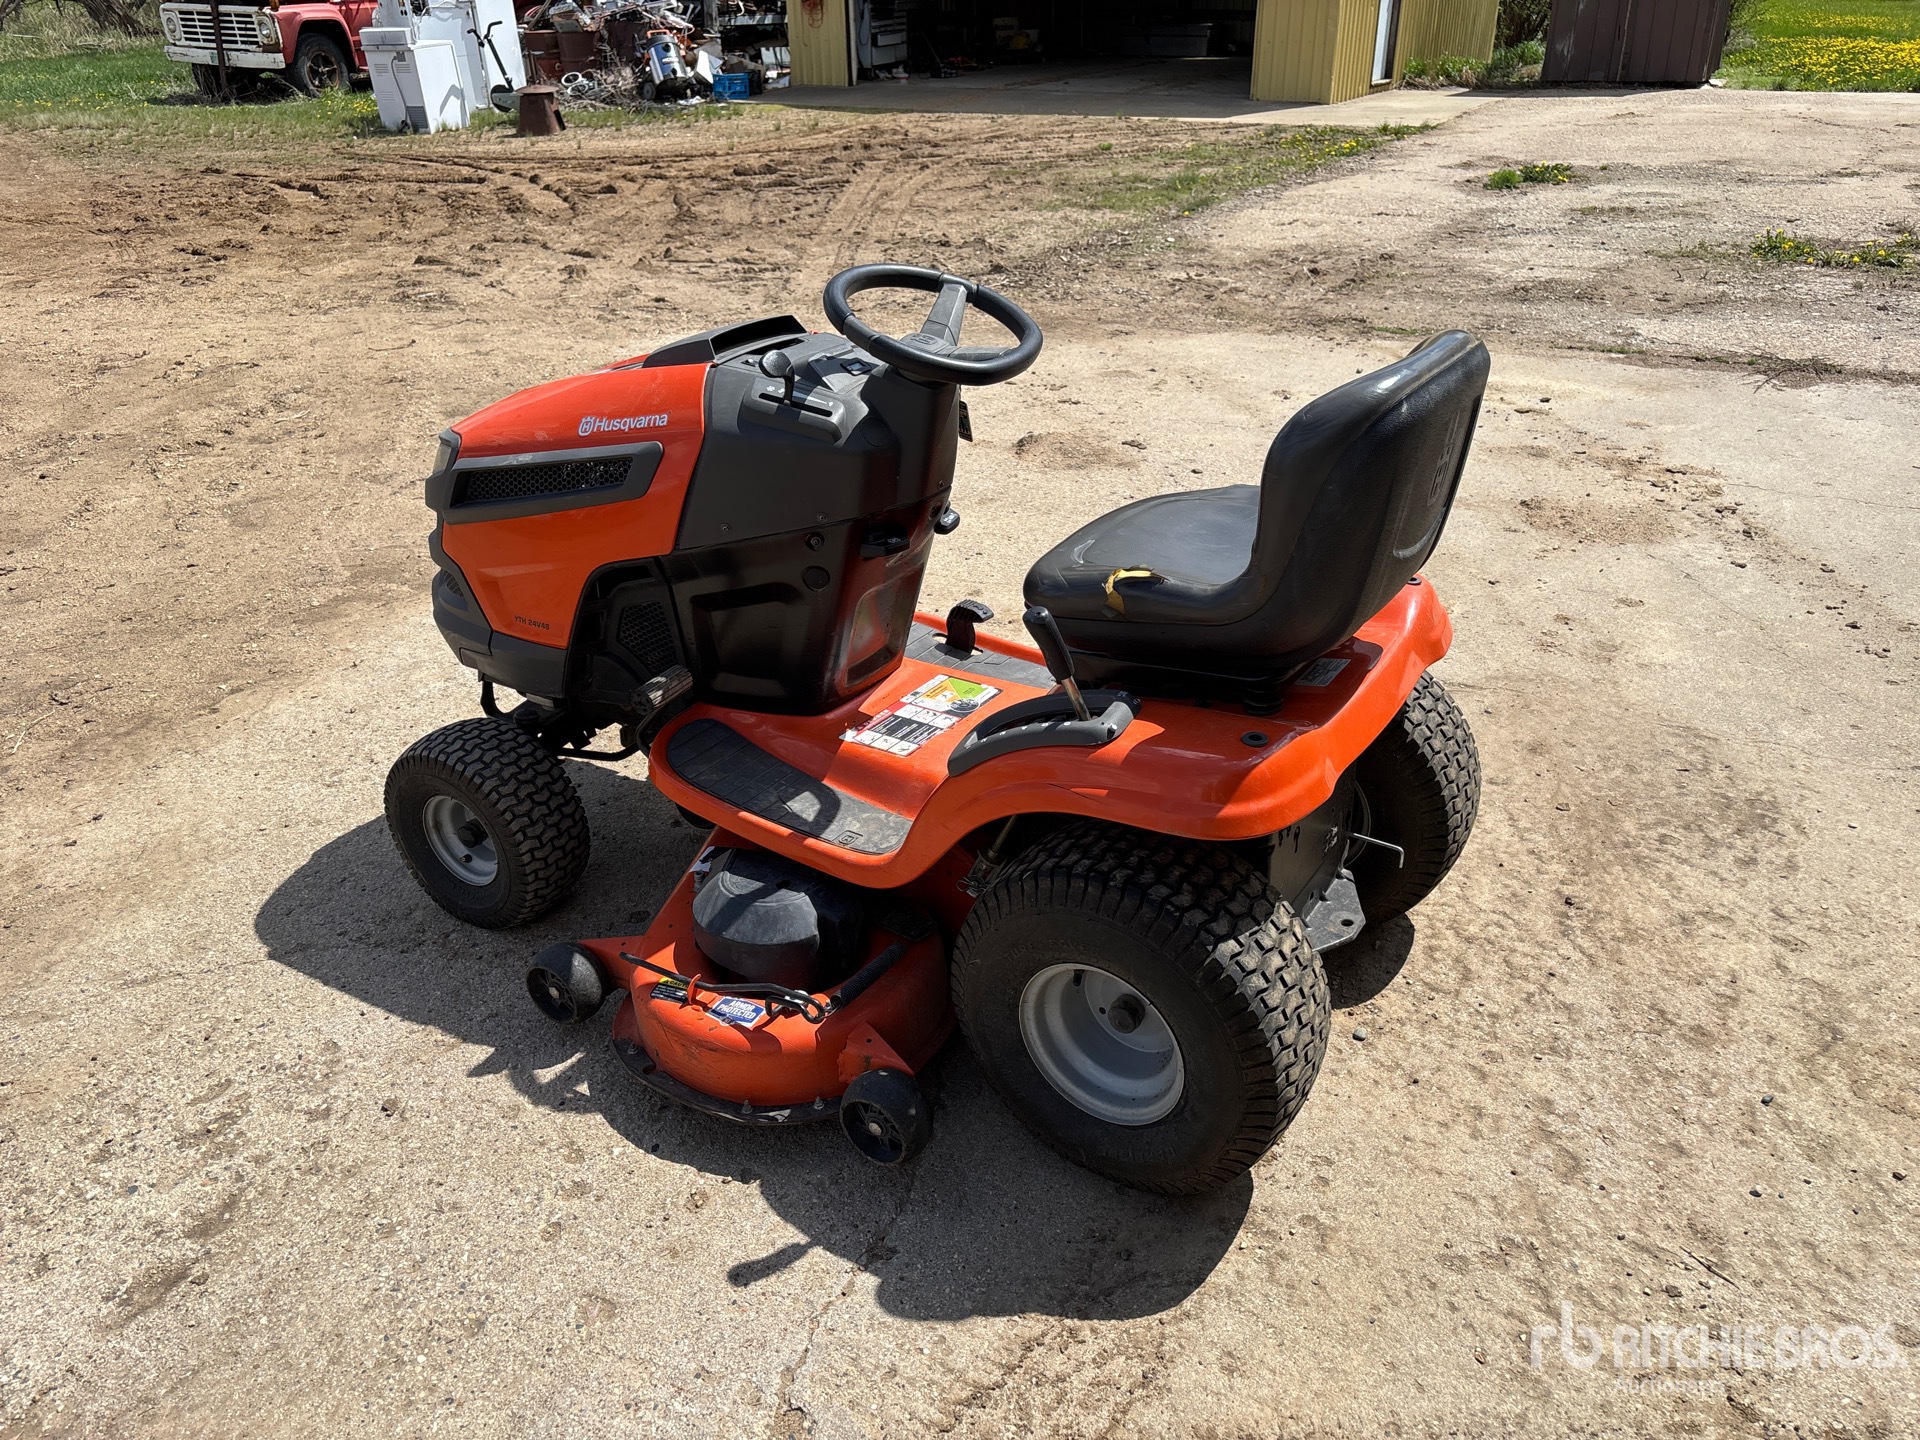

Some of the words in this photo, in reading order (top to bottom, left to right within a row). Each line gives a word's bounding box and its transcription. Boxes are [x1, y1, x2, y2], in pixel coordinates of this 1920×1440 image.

[593, 413, 669, 432] Husqvarna
[514, 615, 527, 625] YTH
[528, 619, 550, 631] 24V48
[716, 1003, 757, 1020] PROTECTED
[728, 1000, 756, 1012] ARMOR
